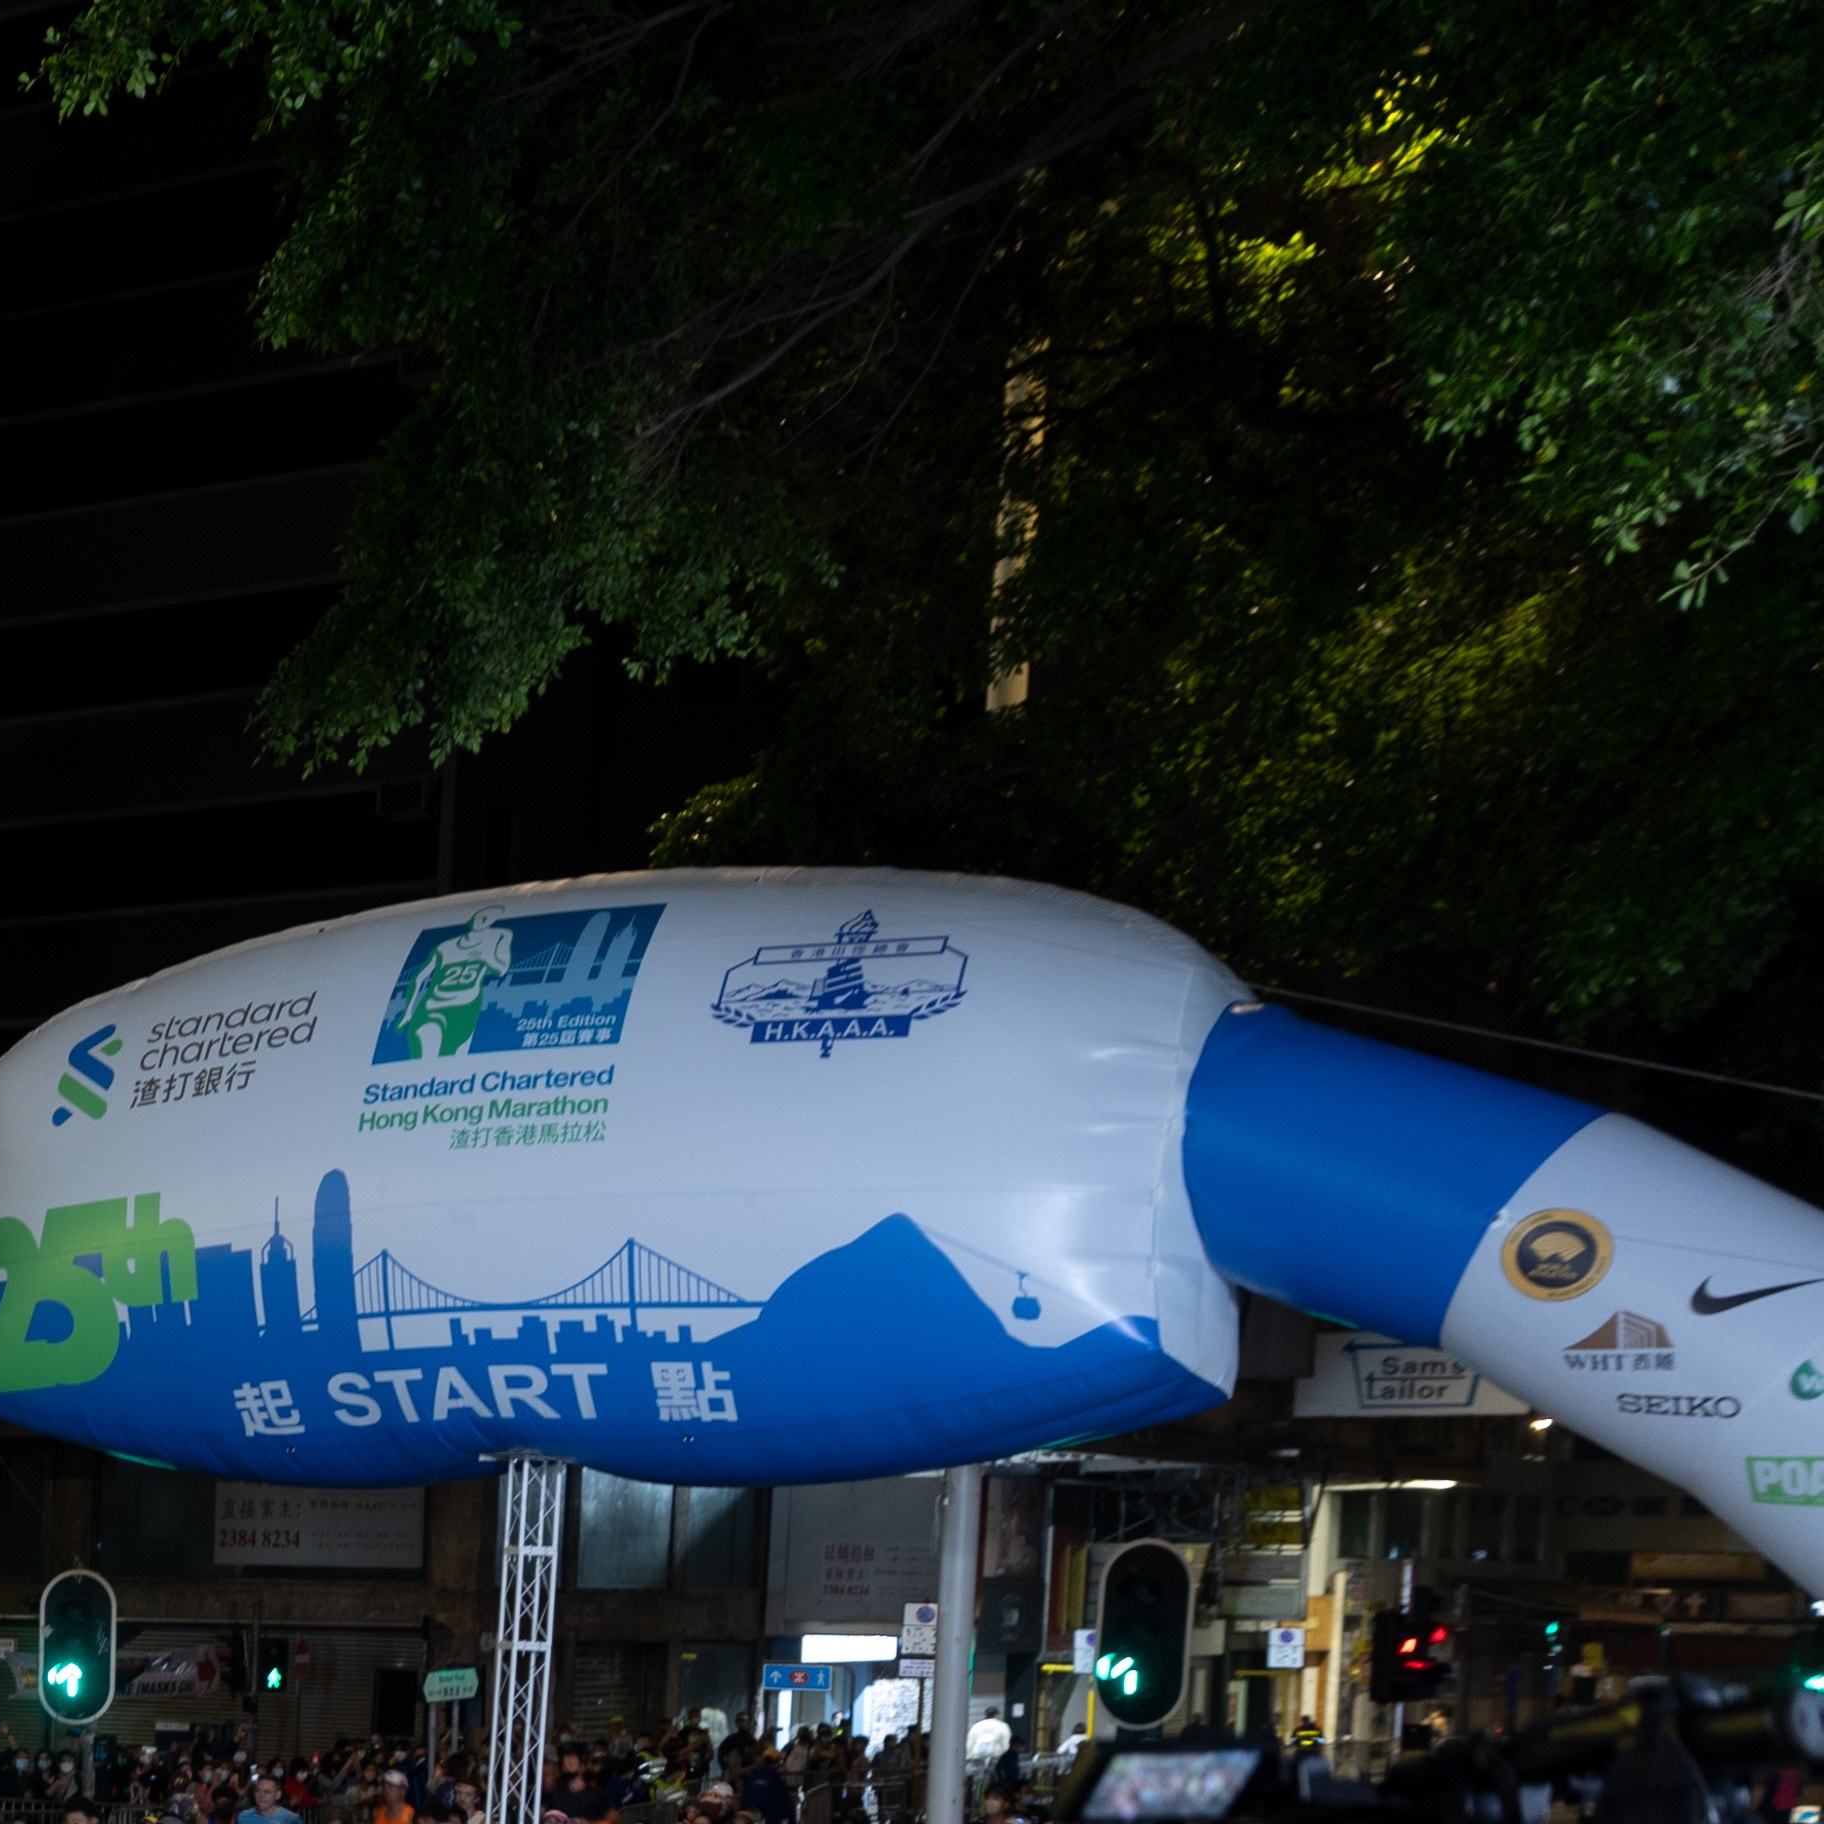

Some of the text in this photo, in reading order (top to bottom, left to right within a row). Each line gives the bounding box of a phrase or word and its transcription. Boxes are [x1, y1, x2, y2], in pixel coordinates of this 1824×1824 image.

[441, 963, 480, 986] 25
[146, 990, 318, 1044] standard
[517, 1011, 617, 1032] 25th Edition
[764, 1017, 895, 1042] H.K.A.A.A.
[139, 1016, 318, 1071] chartered
[129, 1060, 257, 1109] 渣打銀行
[362, 1064, 616, 1106] Standard Chartered
[358, 1094, 610, 1134] Hong Kong Marathon
[448, 1120, 607, 1151] 渣打香港馬拉松
[233, 1378, 306, 1439] 起
[326, 1362, 609, 1427] START
[651, 1359, 739, 1424] 點
[1615, 1392, 1741, 1419] SEIKO
[219, 1528, 301, 1549] 2384 8234
